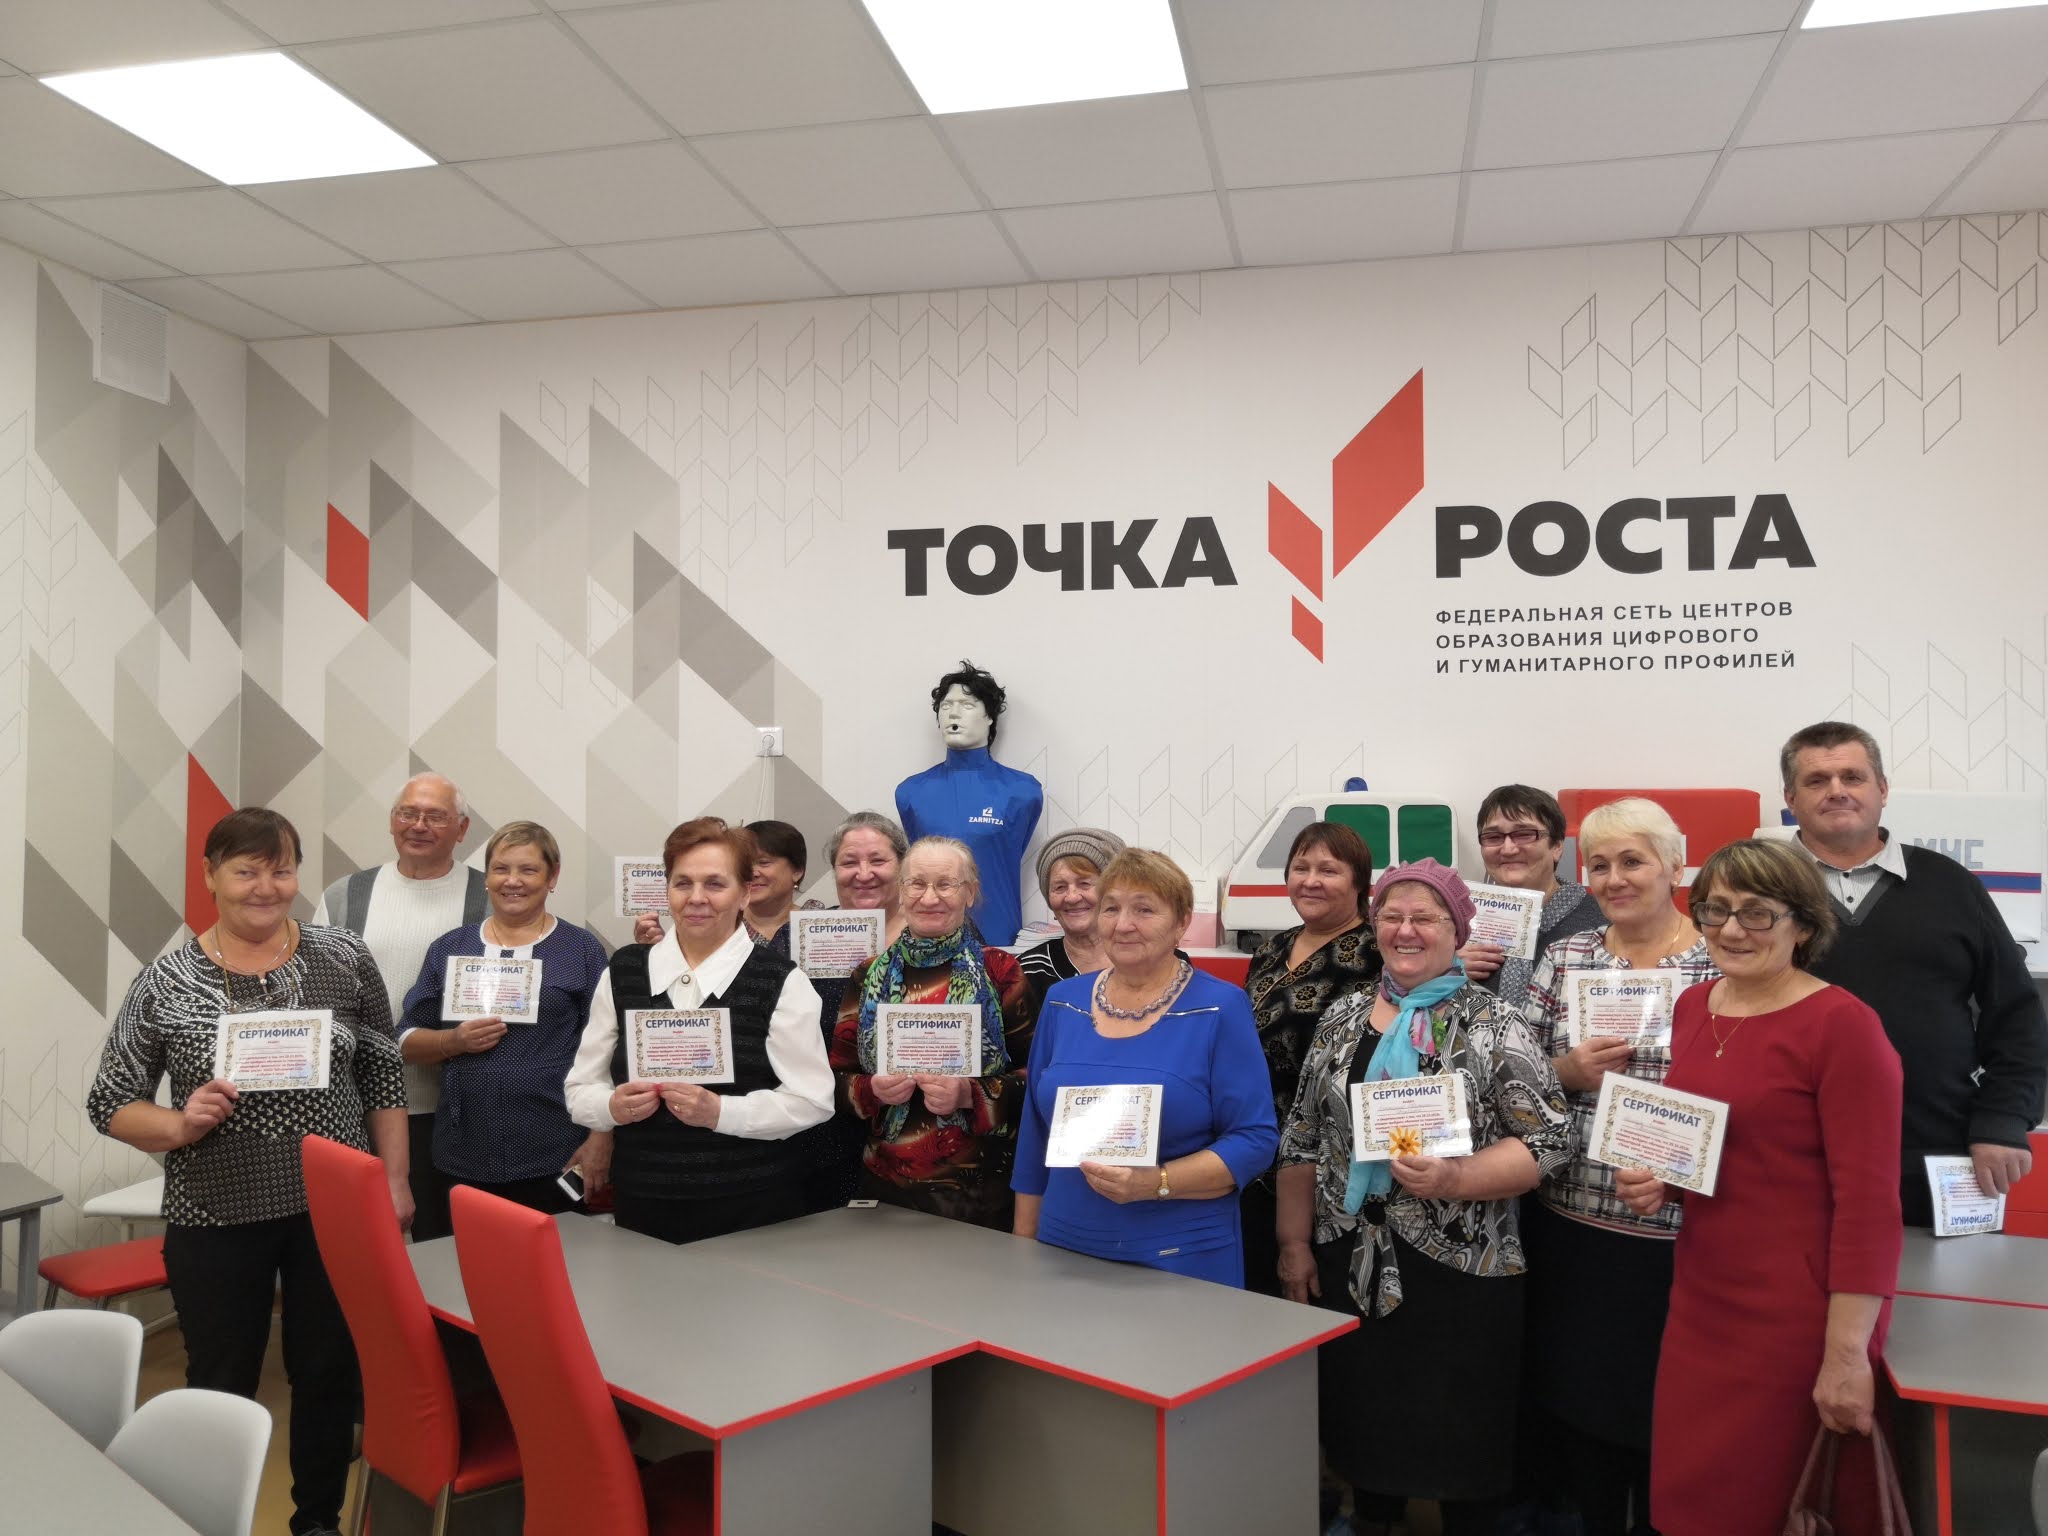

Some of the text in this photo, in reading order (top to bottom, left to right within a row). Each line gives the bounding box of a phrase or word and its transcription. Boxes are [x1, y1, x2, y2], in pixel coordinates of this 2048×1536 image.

[888, 493, 1817, 597] ТОЧКА РОСТА
[1436, 601, 1794, 627] ФЕДЕРАЛЬНАЯ СЕТЬ ЦЕНТРОВ
[1436, 627, 1759, 650] ОБРАЗОВАНИЯ ЦИФРОВОГО
[1436, 649, 1795, 674] И ГУМАНИТАРНОГО ПРОФИЛЕЙ
[968, 816, 1004, 826] ZARNITZA
[631, 870, 667, 878] СЕРТИФ
[808, 924, 869, 934] СЕРТИФИКАТ
[645, 1018, 711, 1029] СЕРТИФИКАТ
[897, 1019, 963, 1029] СЕРТИФИКАТ
[238, 1027, 311, 1040] СЕРТИФИКАТ
[1372, 1085, 1443, 1101] СЕРТИФИКАТ
[1622, 1097, 1702, 1128] СЕРТИФИКАТ
[1950, 1213, 1994, 1226] СЕРТИФИКАТ
